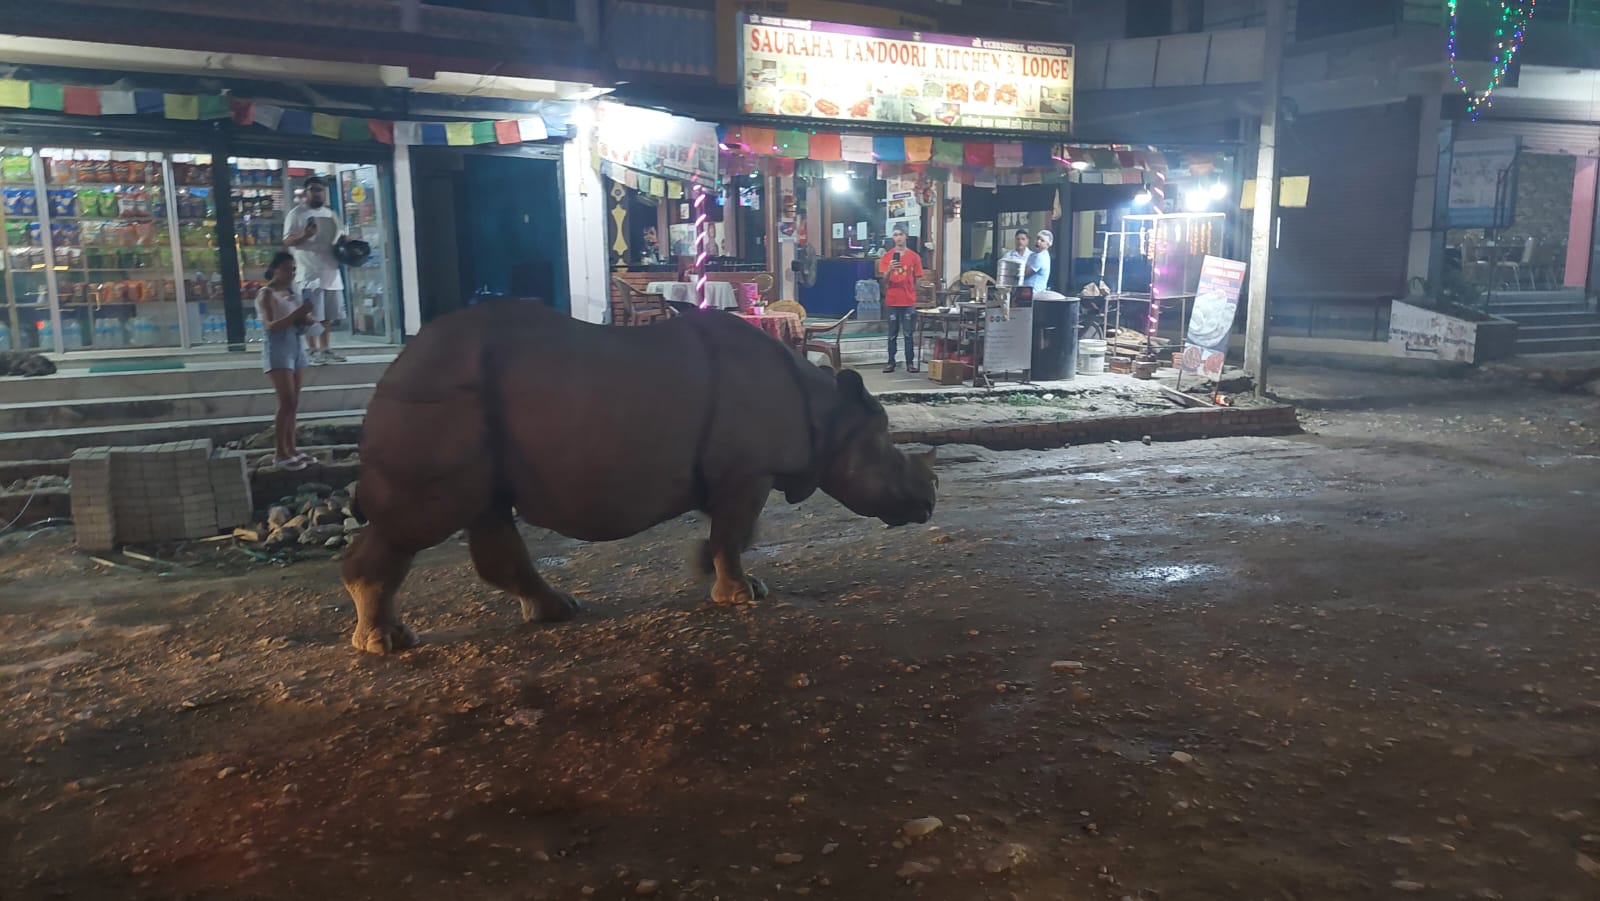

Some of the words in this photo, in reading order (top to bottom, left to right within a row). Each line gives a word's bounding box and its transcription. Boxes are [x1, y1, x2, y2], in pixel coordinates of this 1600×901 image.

[751, 28, 833, 57] SAURAHA
[844, 39, 926, 67] TANDOORI
[935, 47, 1002, 72] KITCHEN
[1022, 55, 1069, 79] LODGE
